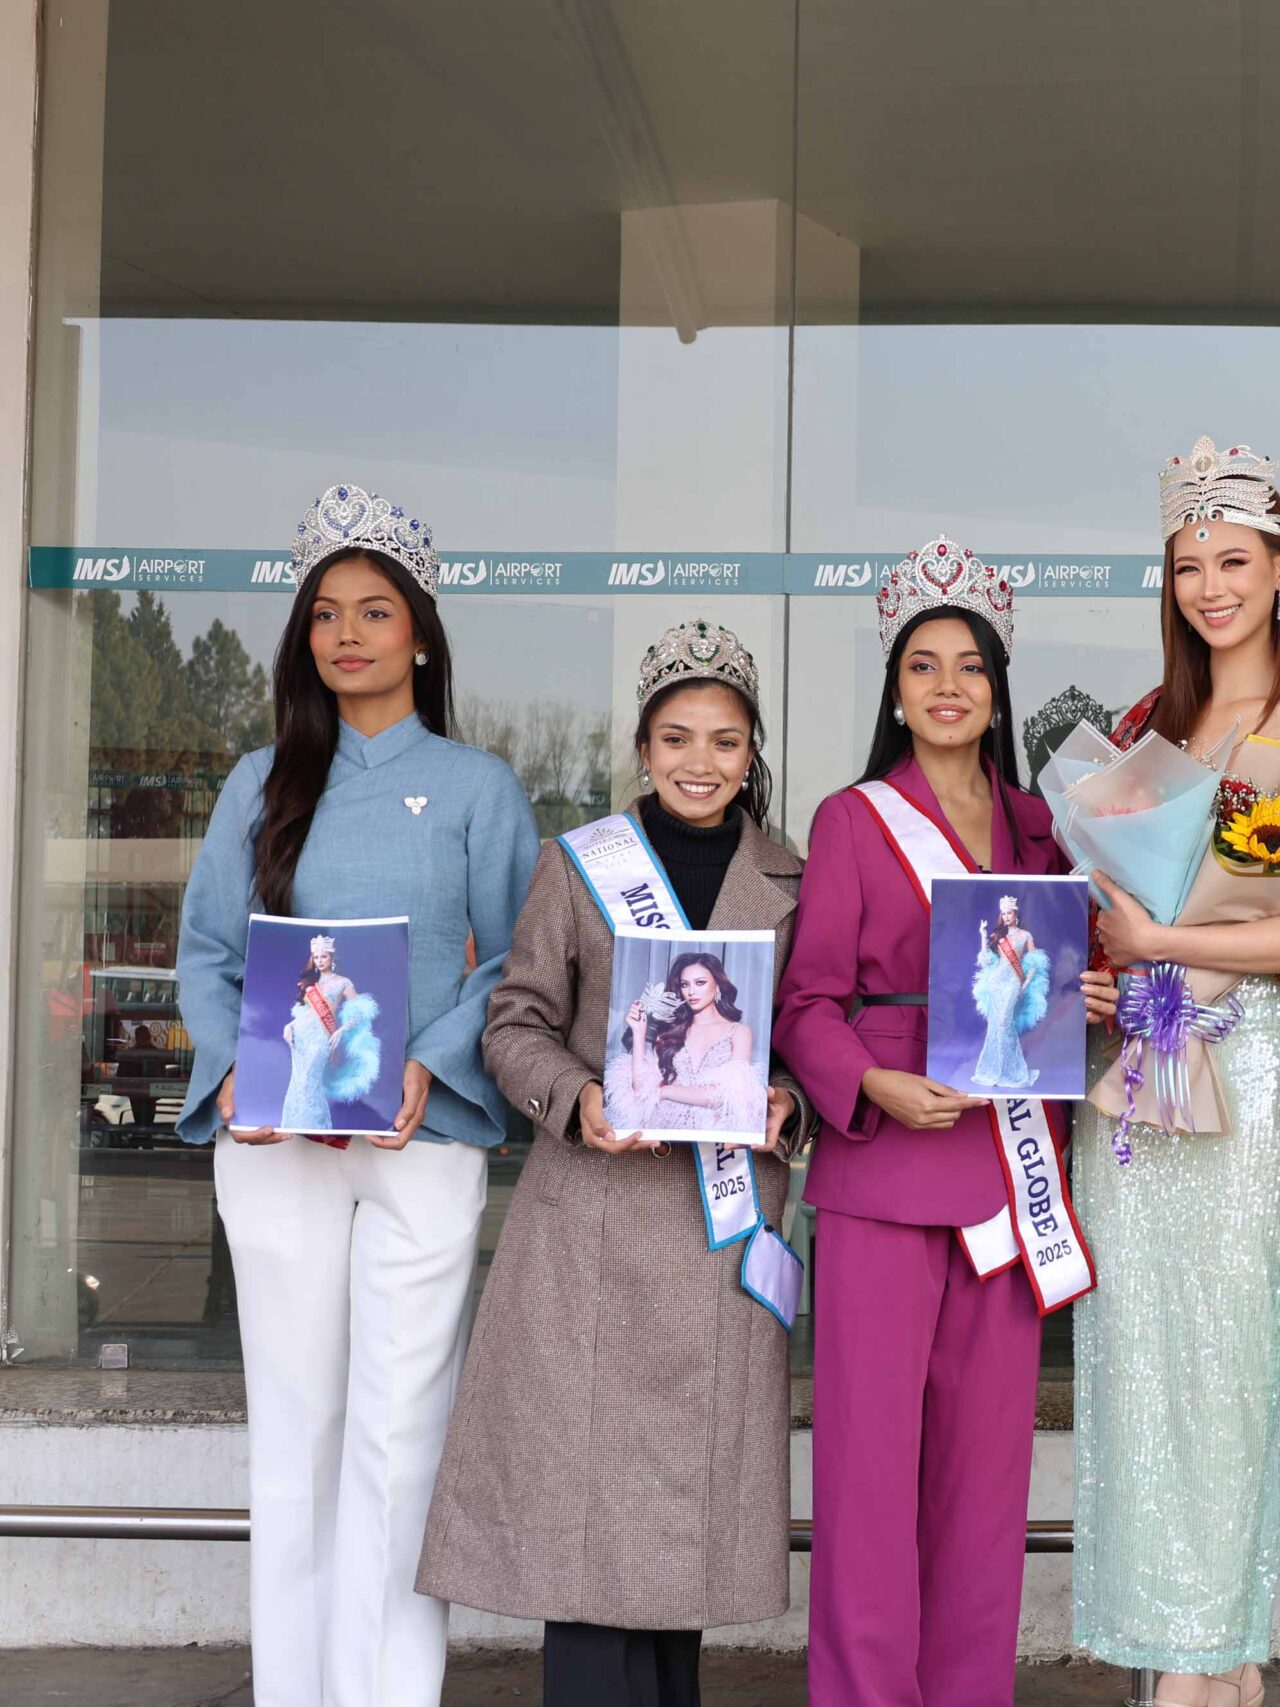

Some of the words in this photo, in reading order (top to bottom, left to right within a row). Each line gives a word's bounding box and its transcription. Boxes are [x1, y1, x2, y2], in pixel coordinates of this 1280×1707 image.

[73, 555, 131, 582] IMS
[138, 558, 206, 575] AIRPORT
[251, 560, 297, 585] IMS
[494, 561, 563, 578] AIRPORT
[608, 559, 666, 586] IMS
[673, 561, 742, 578] AIRPORT
[814, 560, 873, 588] IMS
[1043, 564, 1112, 581] AIRPORT
[138, 575, 204, 583] SERVICES
[494, 578, 561, 586] SERVICES
[673, 578, 741, 586] SERVICES
[1043, 581, 1110, 589] SERVICES
[582, 836, 636, 860] NATIONAL
[711, 1175, 746, 1201] 2025
[1016, 1137, 1059, 1237] GLOBE
[1036, 1239, 1072, 1267] 2025
